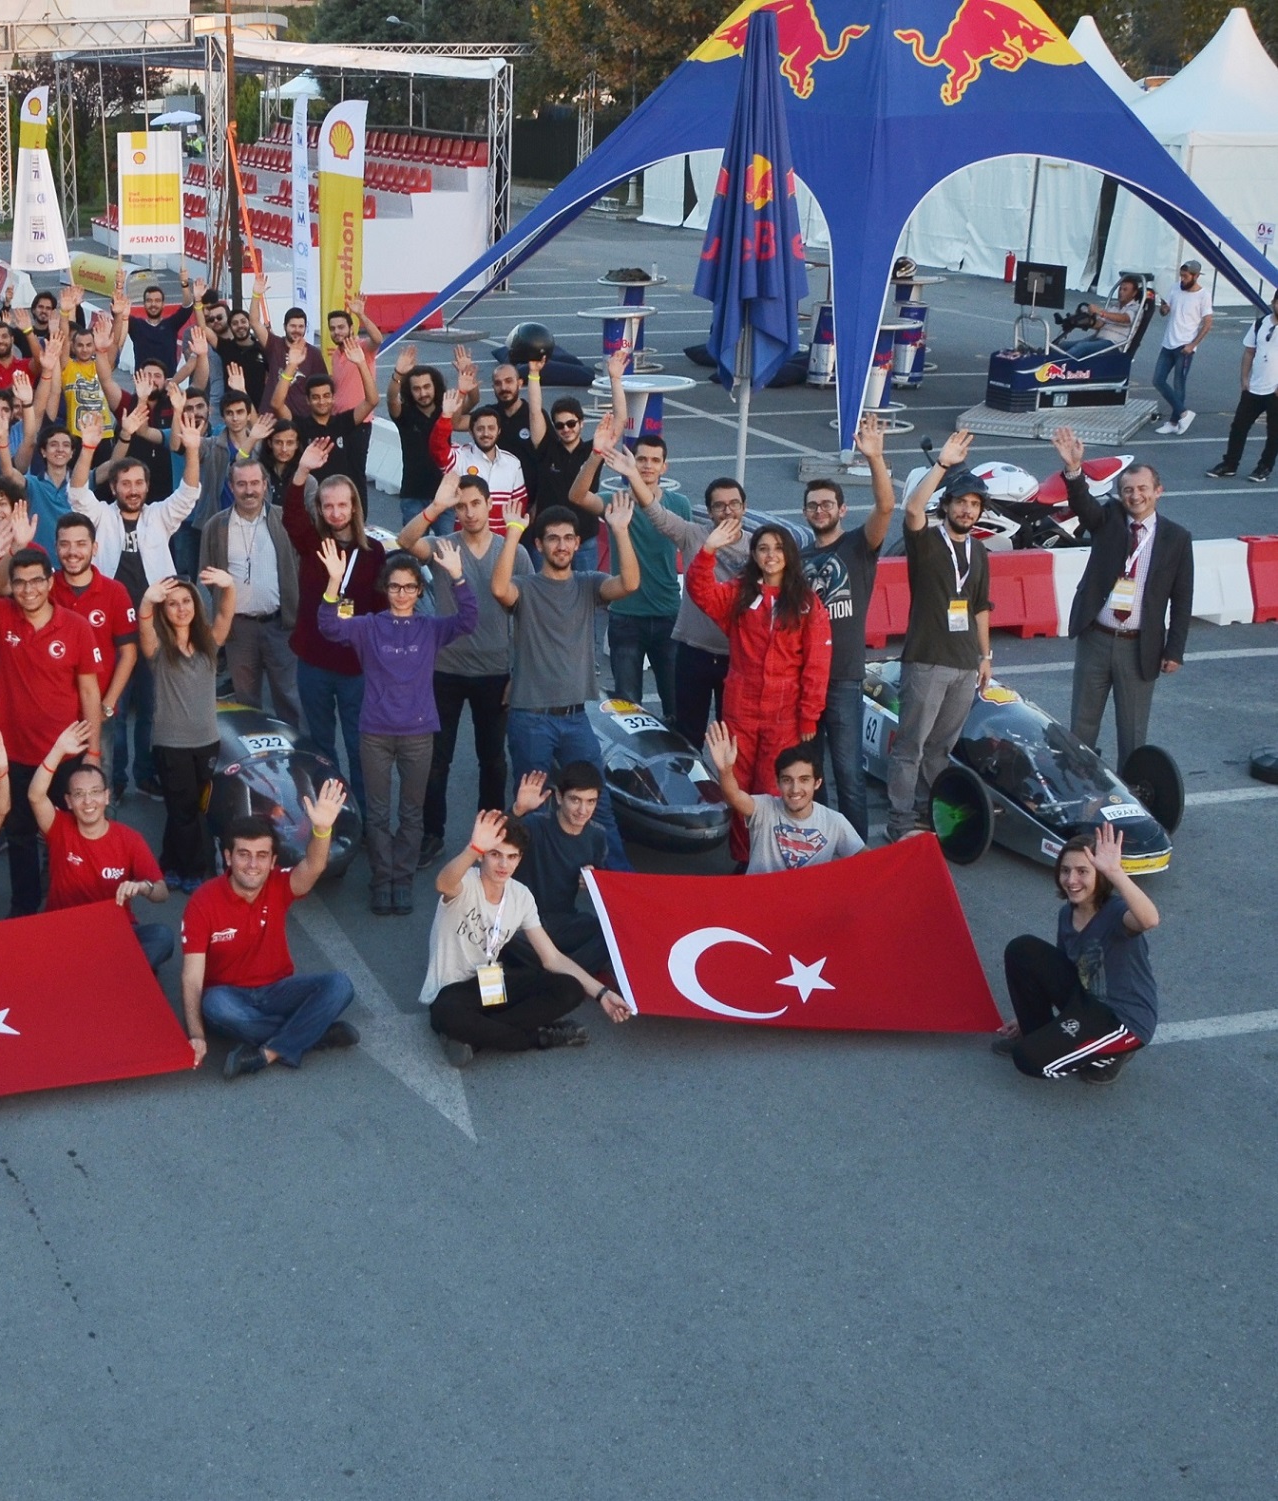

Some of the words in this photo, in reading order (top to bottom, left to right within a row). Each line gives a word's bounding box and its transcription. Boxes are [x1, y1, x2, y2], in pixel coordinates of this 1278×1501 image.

[130, 234, 176, 244] #SEM2016
[828, 599, 853, 620] TION
[624, 716, 660, 730] 325
[865, 717, 878, 744] 62
[248, 737, 284, 750] 322
